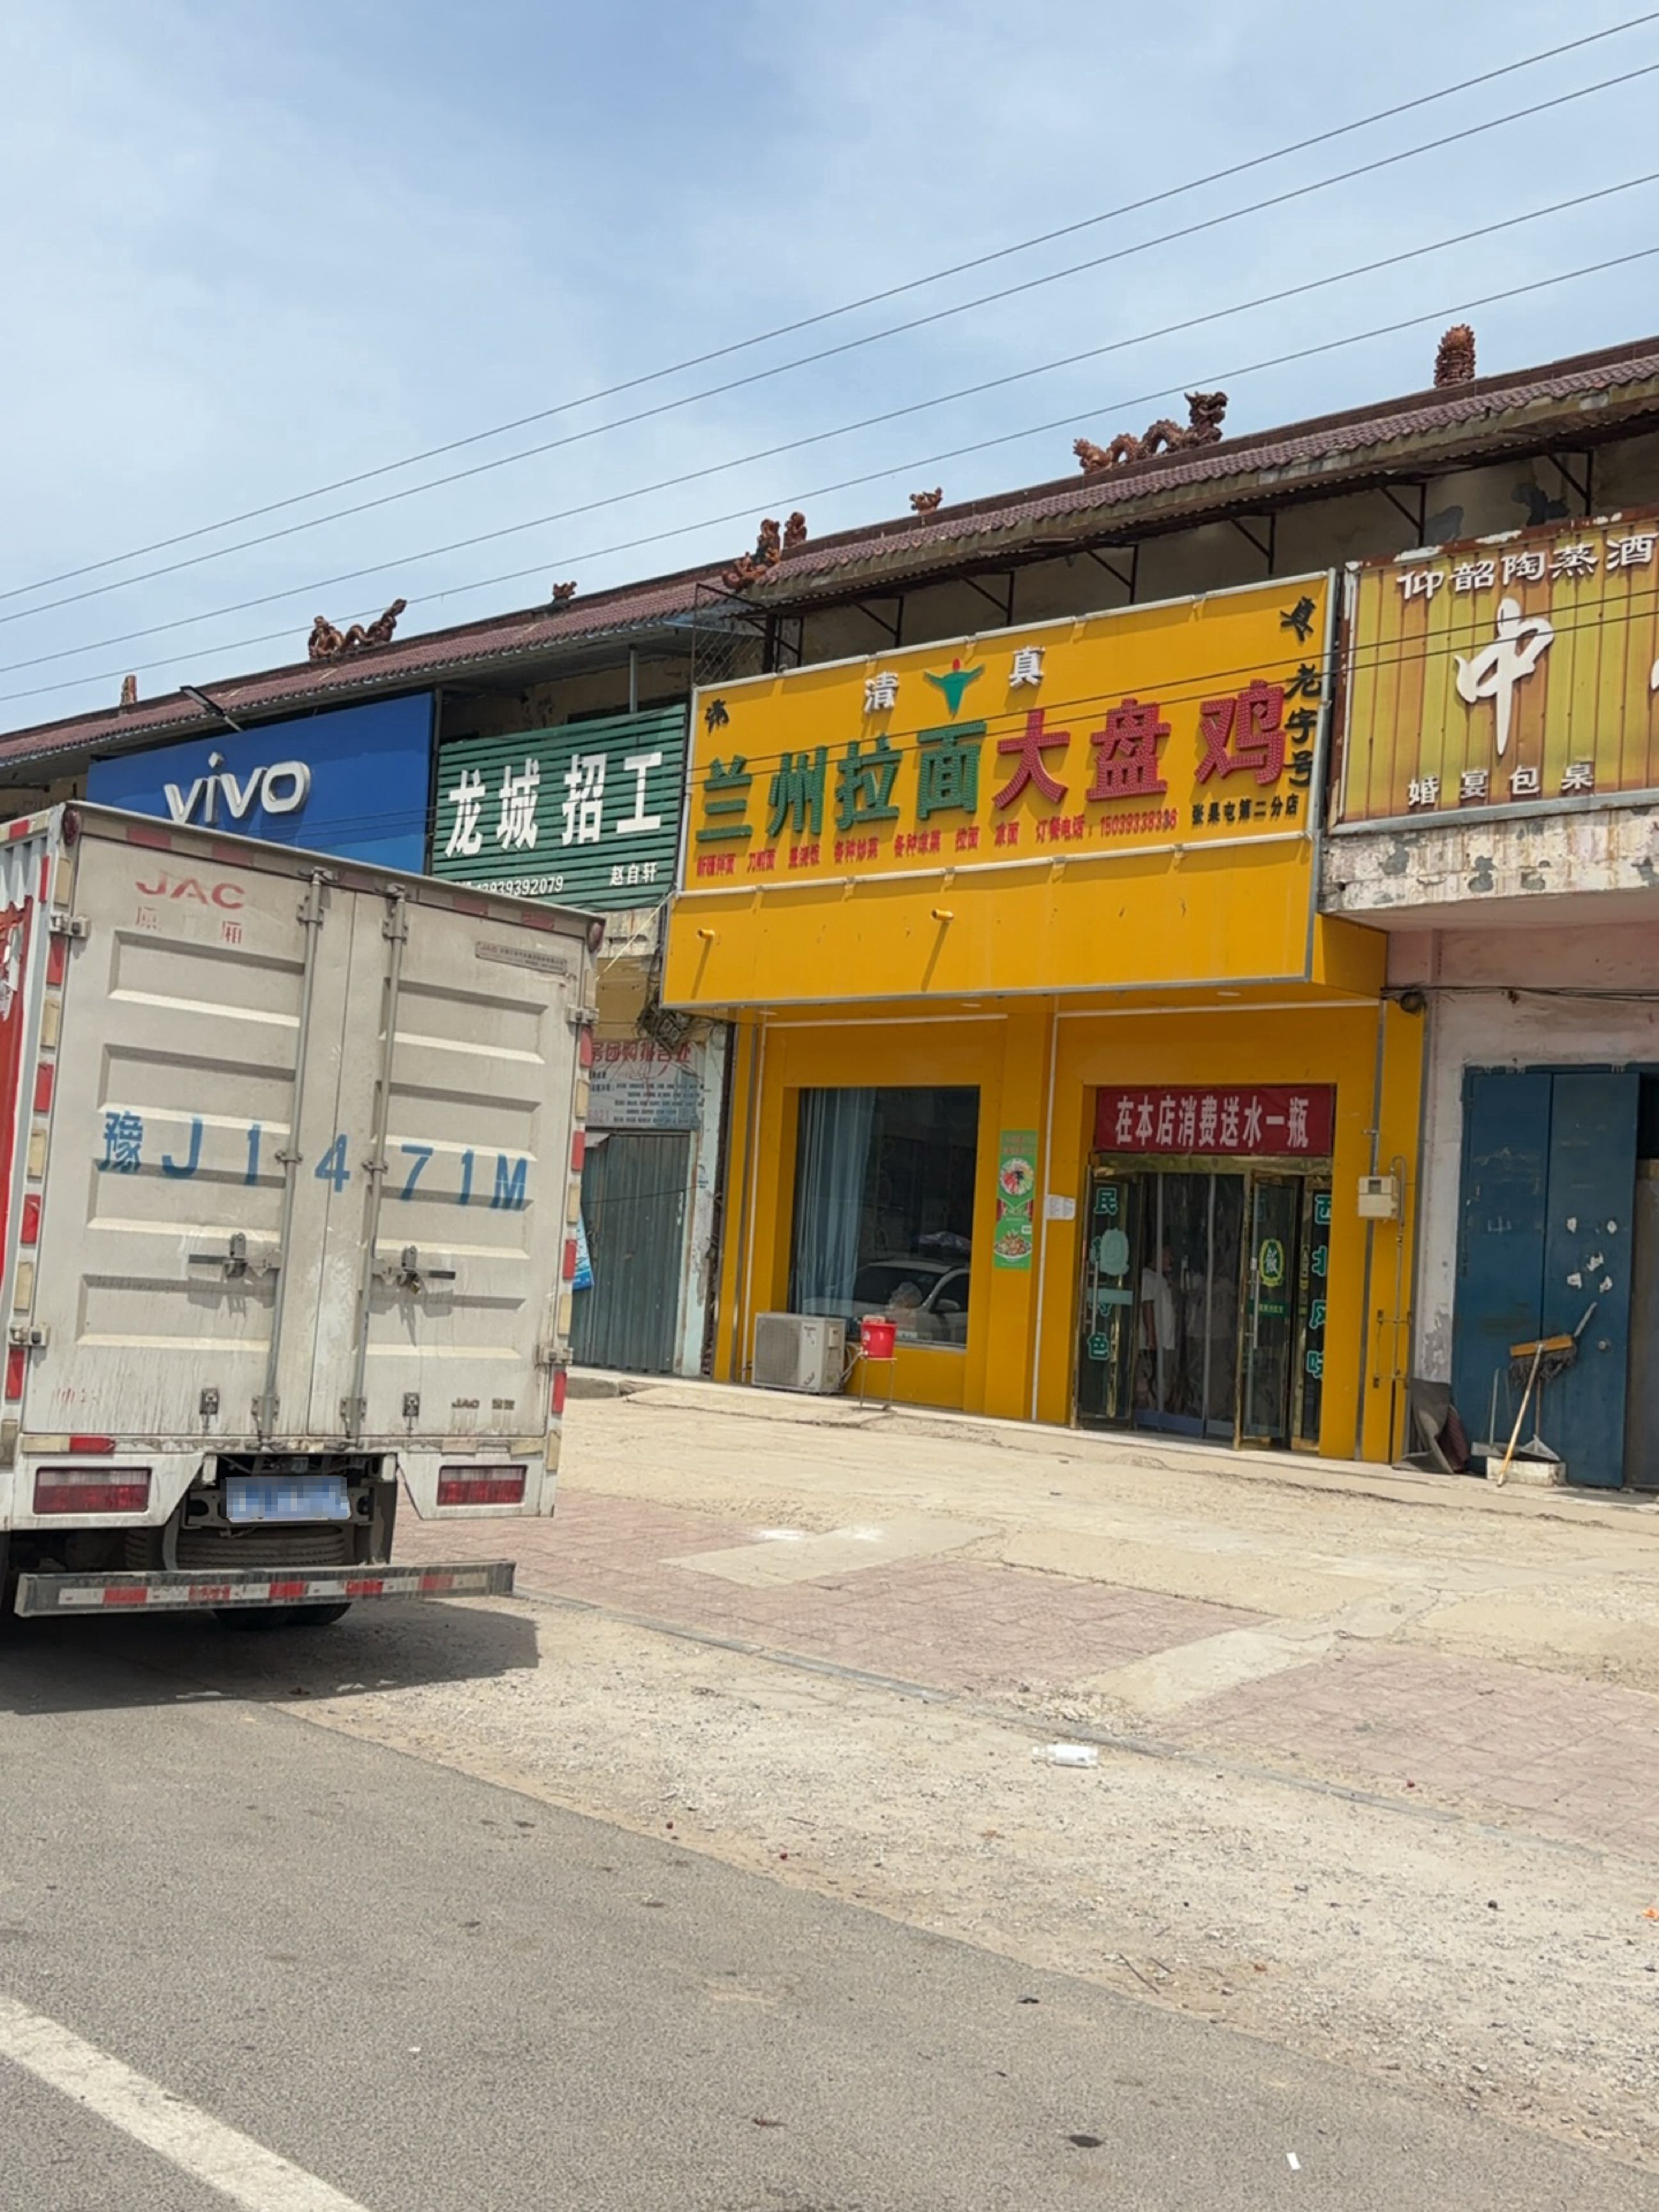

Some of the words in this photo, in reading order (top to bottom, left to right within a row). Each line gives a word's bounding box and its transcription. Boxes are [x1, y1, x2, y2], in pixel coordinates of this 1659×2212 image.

[1396, 533, 1659, 600] 仰韶陶蒸酒
[864, 669, 899, 714] 清
[1008, 646, 1045, 687] 真
[1283, 662, 1323, 788] 老字号
[164, 751, 311, 823] vivo
[445, 751, 663, 858] 龙城招工
[135, 873, 246, 910] JAC
[477, 875, 564, 896] 939392079
[1115, 1094, 1310, 1149] 在本店消费送水一瓶
